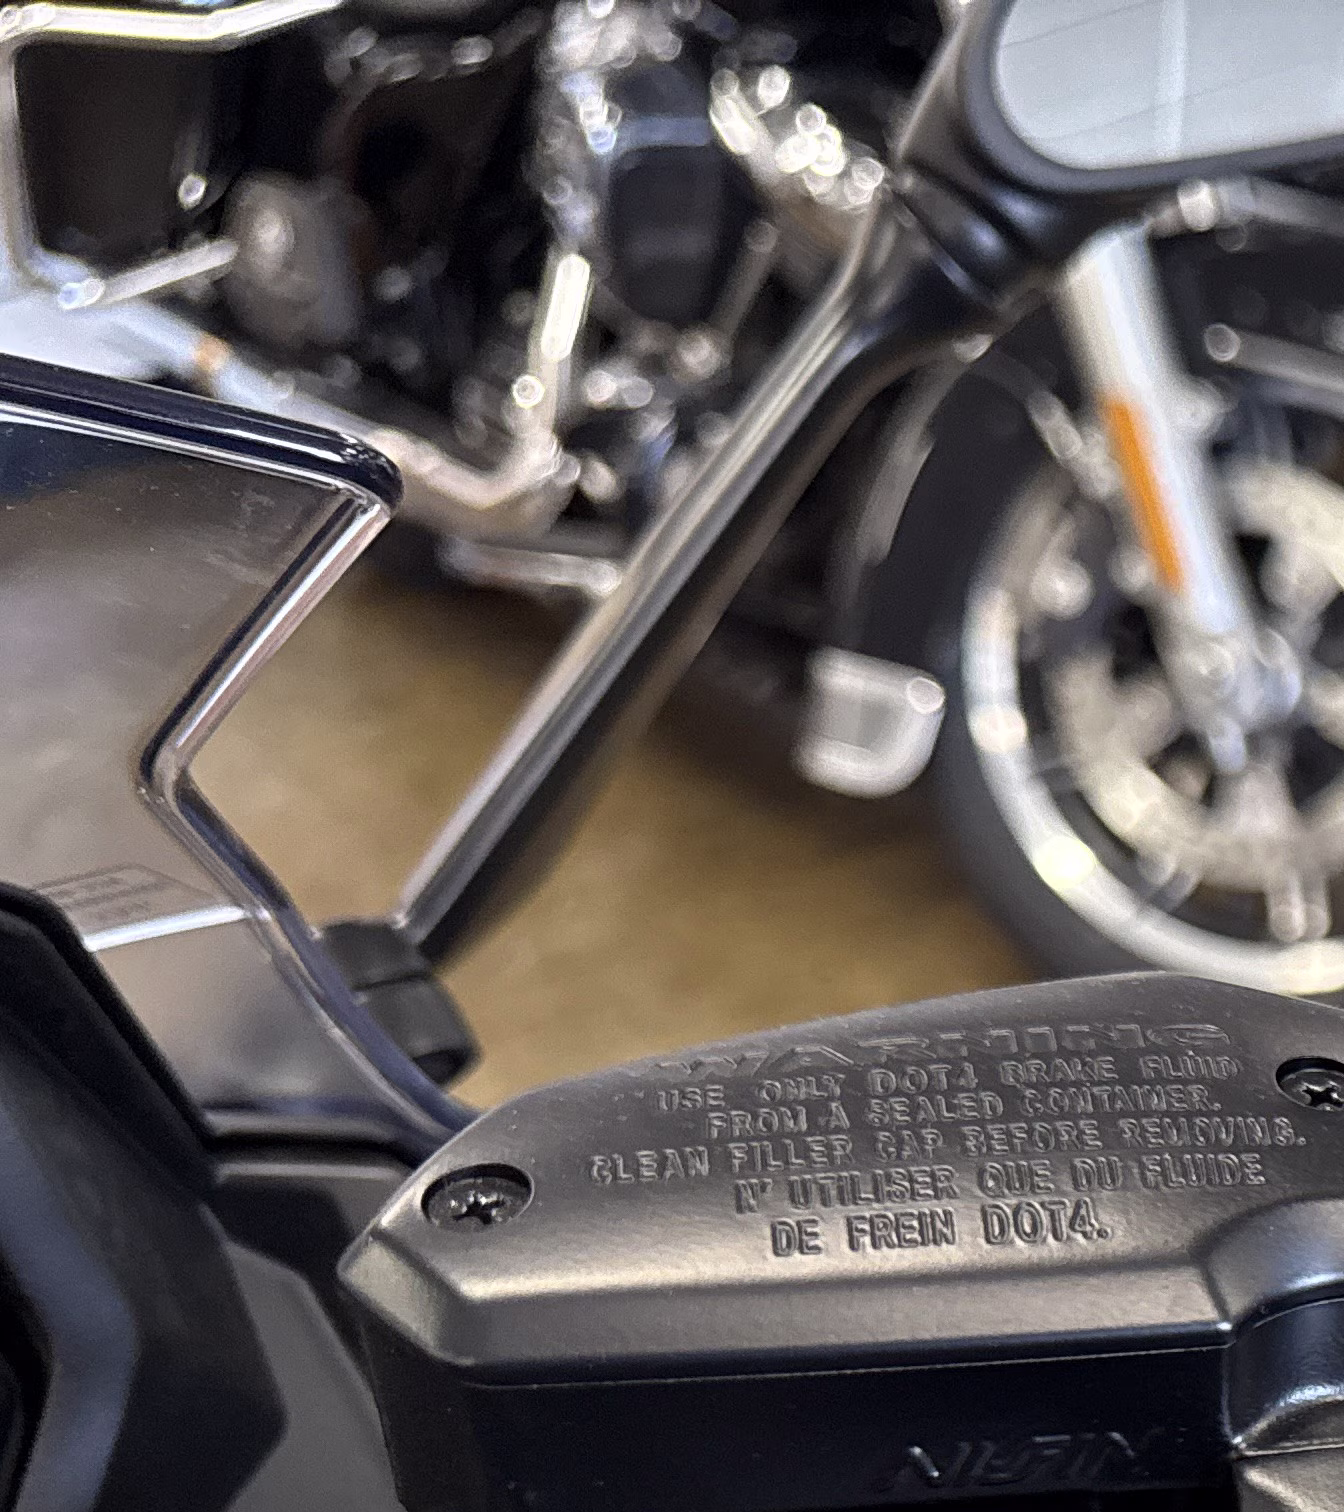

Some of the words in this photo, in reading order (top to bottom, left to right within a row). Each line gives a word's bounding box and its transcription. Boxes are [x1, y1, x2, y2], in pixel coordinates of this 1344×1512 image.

[657, 1084, 726, 1112] USE
[755, 1072, 846, 1103] ONLY
[867, 1060, 979, 1098] DOT4
[1000, 1056, 1119, 1086] BRAKE
[1140, 1054, 1242, 1081] FLUID
[706, 1105, 808, 1140] FROM
[820, 1101, 850, 1130] A
[866, 1091, 1004, 1128] SEALED
[1020, 1083, 1223, 1118] CONTAINER.
[589, 1145, 711, 1187] CLEAN
[728, 1133, 854, 1174] FILLER
[875, 1128, 944, 1163] CAP
[962, 1119, 1103, 1157] BEFORE
[1117, 1115, 1307, 1149] REMOVING.
[788, 1164, 961, 1211] UTILISER
[977, 1158, 1056, 1197] QUE
[1070, 1155, 1123, 1192] DU
[1140, 1151, 1267, 1190] FLUIDE
[770, 1216, 825, 1258] DE
[845, 1206, 959, 1253] FREIN
[980, 1197, 1113, 1247] DOT4.
